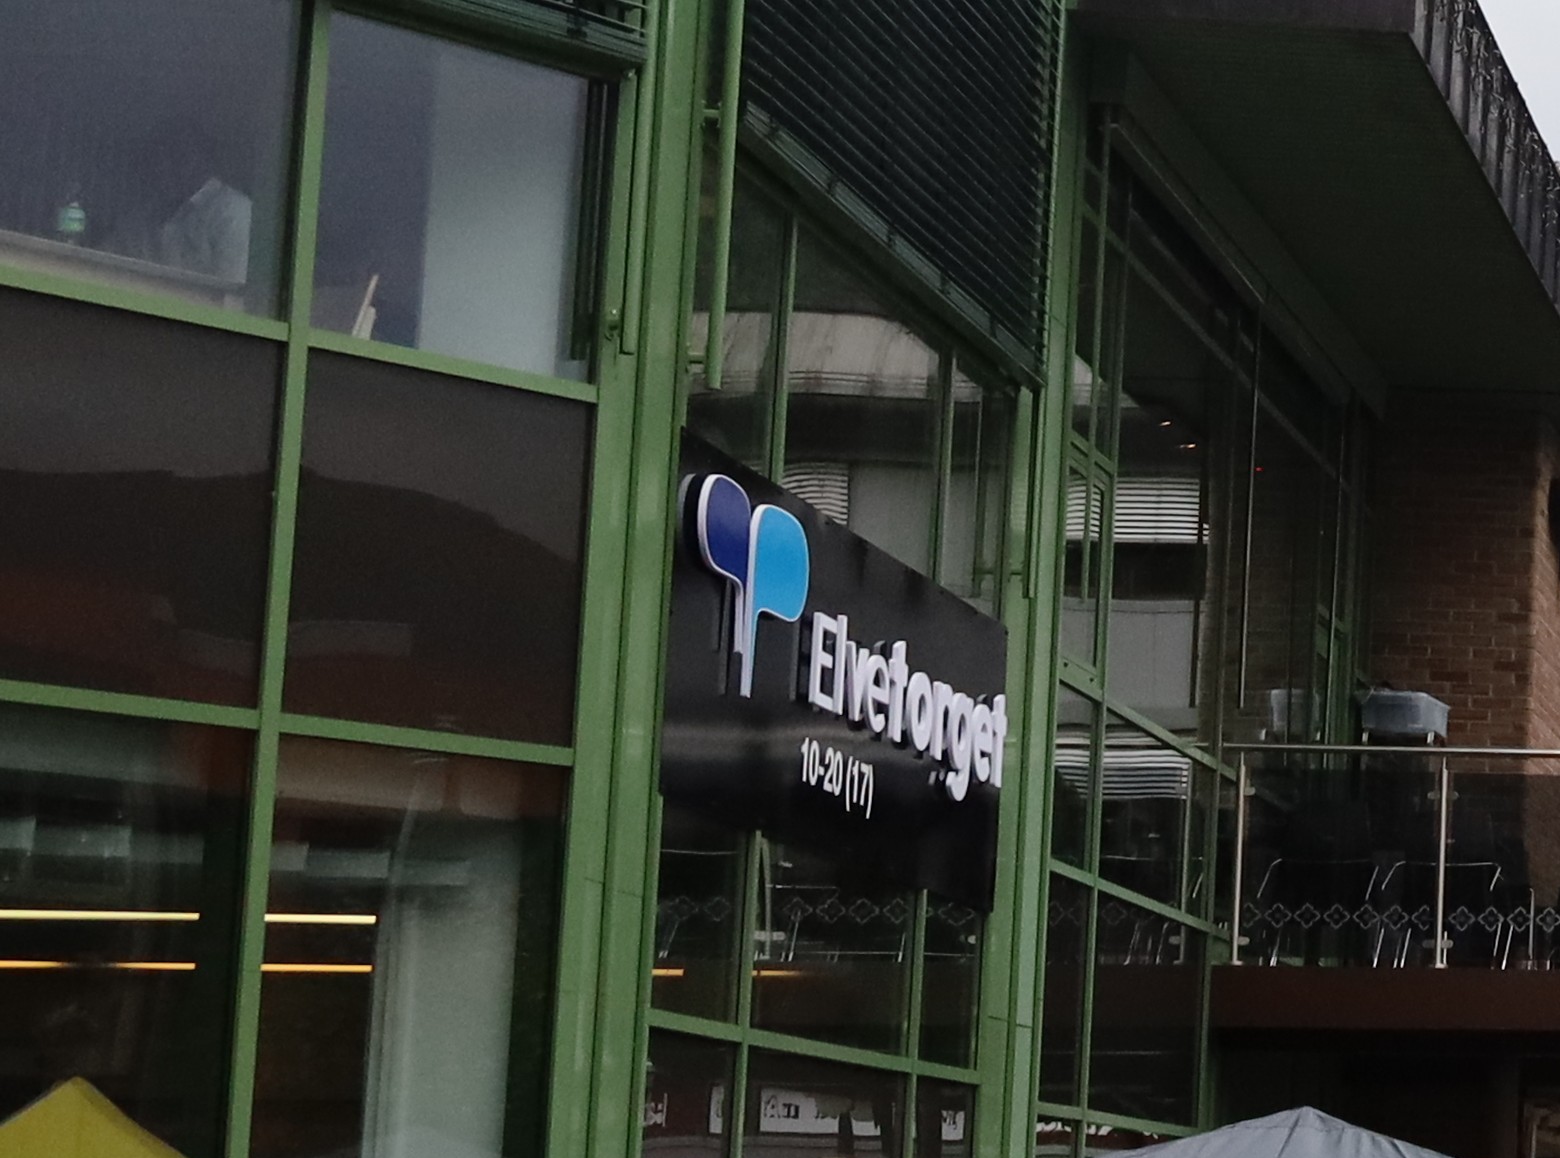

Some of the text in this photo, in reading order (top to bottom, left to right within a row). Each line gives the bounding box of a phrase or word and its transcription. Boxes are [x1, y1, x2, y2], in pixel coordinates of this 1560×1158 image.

[809, 611, 1007, 801] Elvetorget
[801, 737, 875, 819] 10-20 (17)
